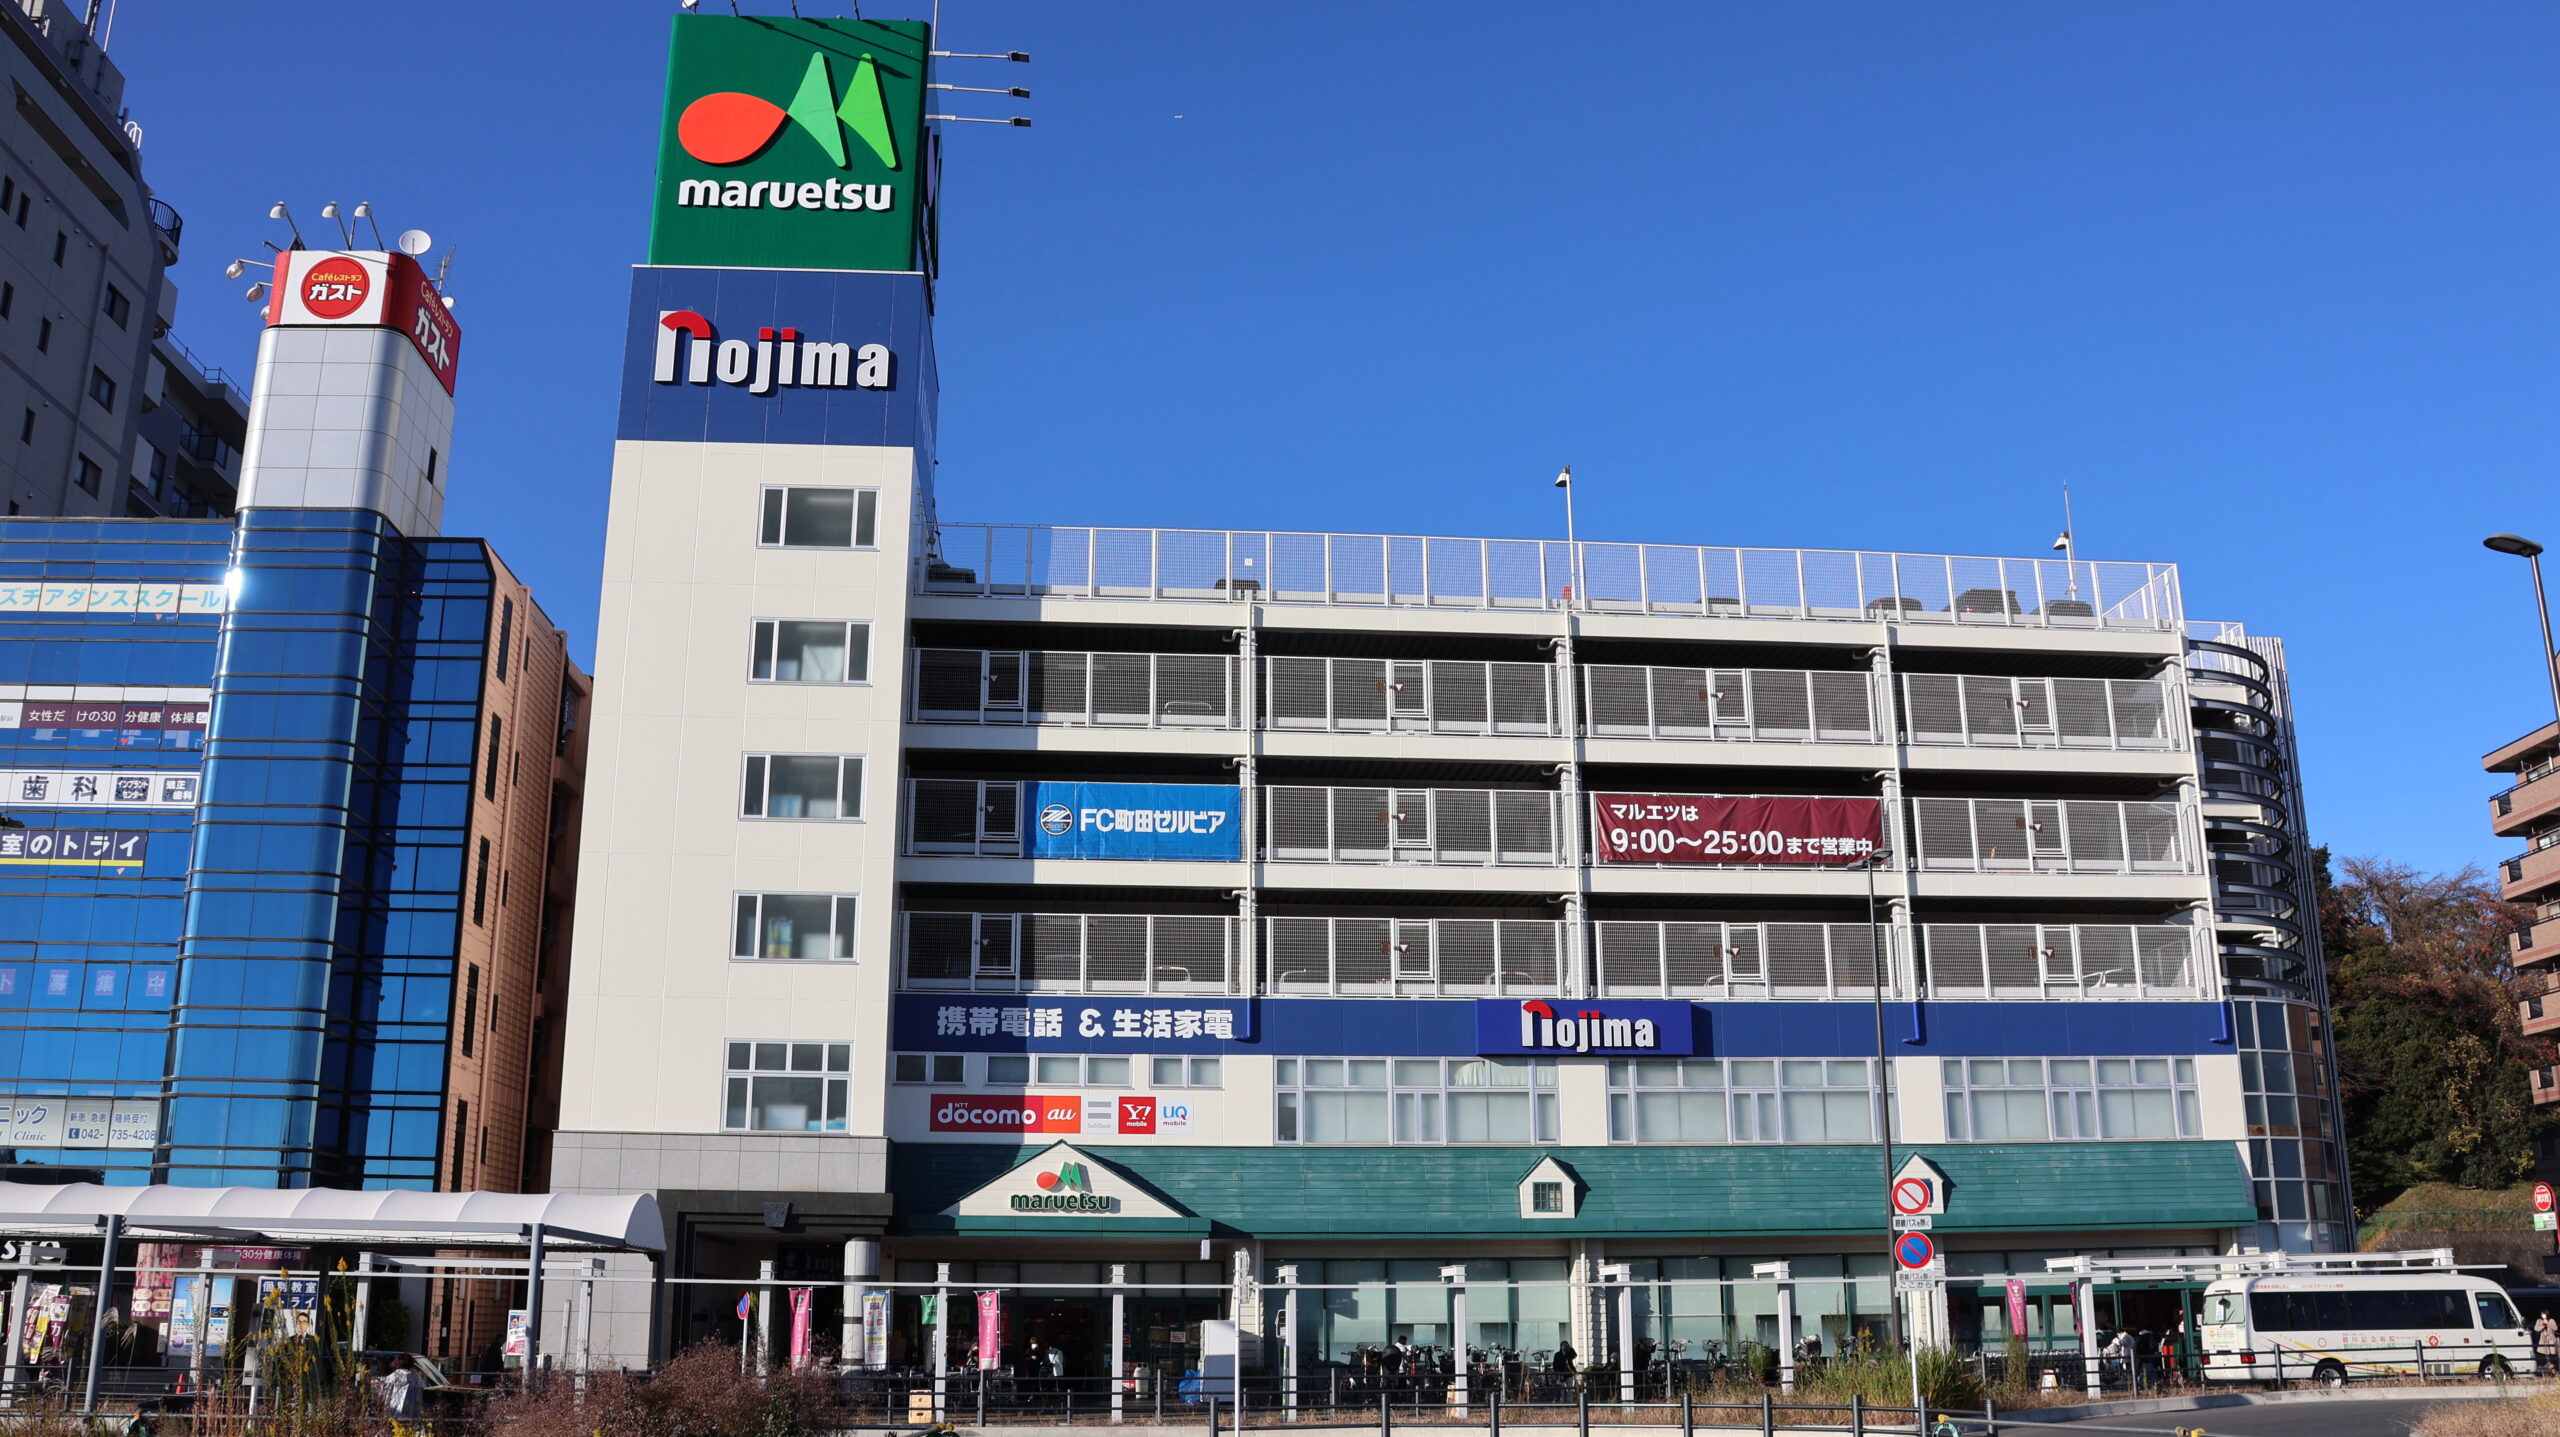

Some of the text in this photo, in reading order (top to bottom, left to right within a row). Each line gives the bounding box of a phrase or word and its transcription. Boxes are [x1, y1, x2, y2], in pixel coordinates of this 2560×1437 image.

[678, 177, 892, 211] maruetsu
[308, 283, 363, 301] ガスト
[415, 306, 450, 371] ガスト
[654, 310, 890, 393] nojima
[1, 588, 220, 608] ズチアダンススクール
[22, 775, 97, 802] 歯科
[1080, 808, 1226, 833] FC町田ゼルビア
[1610, 804, 1699, 821] マルエツは
[0, 833, 140, 857] 室のトライ
[937, 1006, 1234, 1039] 携帯電話 & 生活家電
[1521, 1000, 1655, 1053] nojima
[937, 1102, 1037, 1125] docomo
[1047, 1108, 1077, 1121] au
[1163, 1105, 1188, 1120] UQ
[14, 1131, 47, 1141] Clinic
[1010, 1193, 1112, 1211] maruetsu
